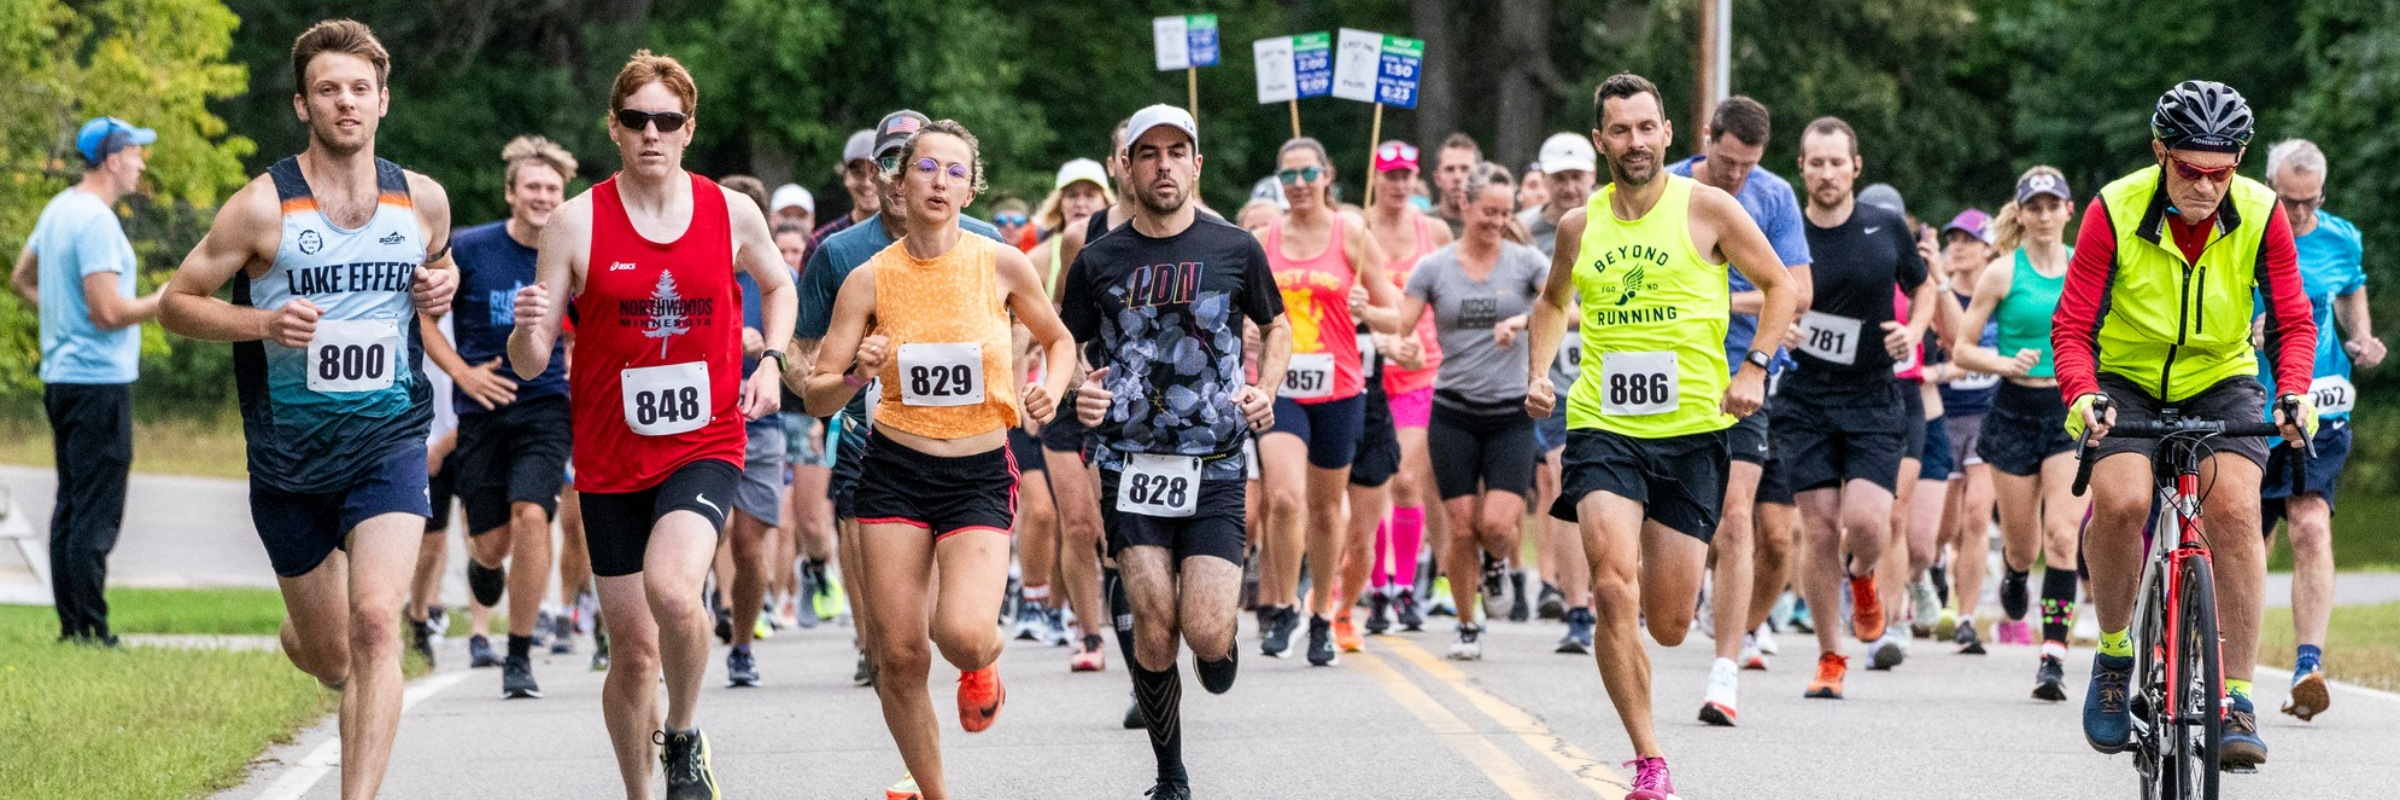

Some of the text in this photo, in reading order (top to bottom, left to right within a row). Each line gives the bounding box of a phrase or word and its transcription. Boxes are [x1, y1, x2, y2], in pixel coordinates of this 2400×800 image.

[1594, 244, 1670, 274] BEYOND
[286, 264, 344, 296] LAKE
[1128, 261, 1204, 310] LDN
[1646, 283, 1659, 291] ND
[619, 298, 713, 317] NORTHWOODS
[1597, 306, 1677, 326] RUNNING
[620, 318, 711, 328] MINNESOTA
[1809, 326, 1847, 355] 781
[319, 343, 385, 380] 800
[910, 364, 972, 396] 829
[1286, 369, 1325, 391] 857
[1610, 372, 1669, 406] 886
[636, 386, 699, 426] 848
[1202, 452, 1227, 461] ATHAN
[1129, 473, 1188, 508] 828
